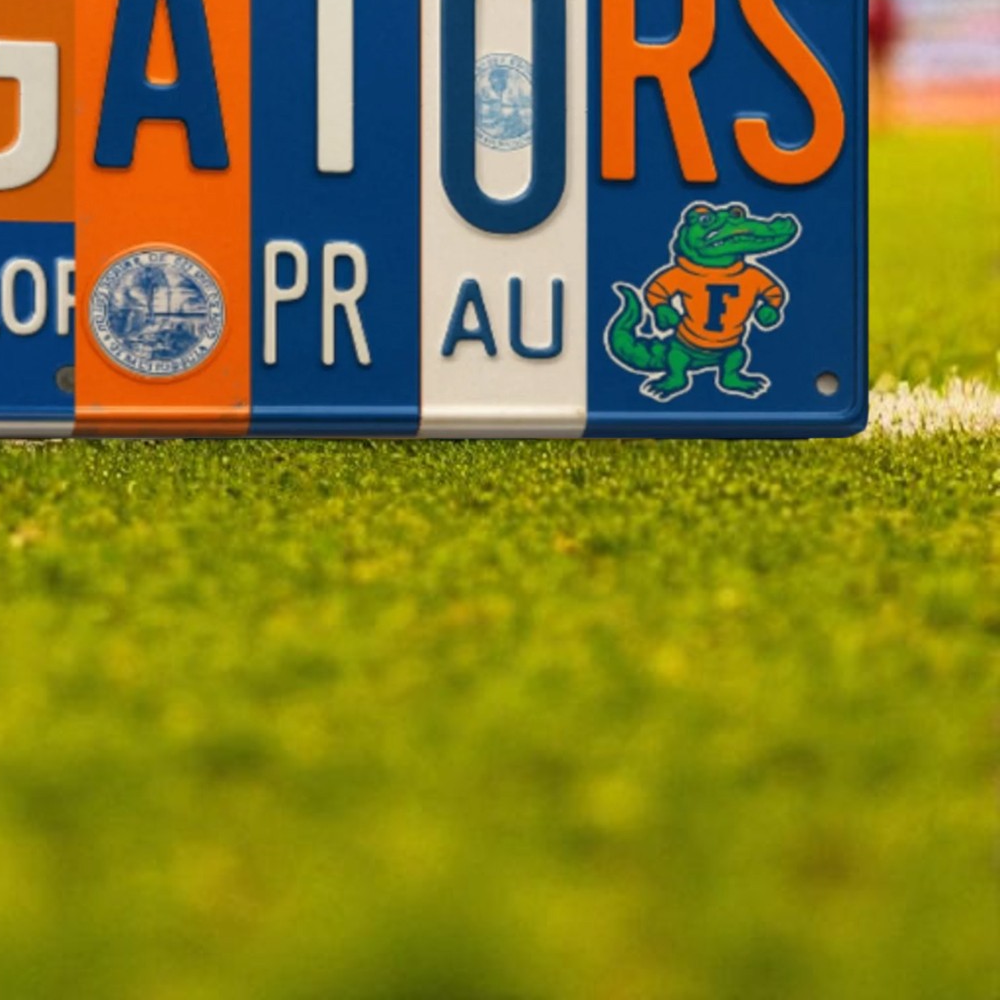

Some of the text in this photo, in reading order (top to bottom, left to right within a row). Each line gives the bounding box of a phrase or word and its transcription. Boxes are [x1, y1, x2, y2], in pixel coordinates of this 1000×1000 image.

[263, 240, 371, 366] PR
[440, 276, 564, 360] AU
[703, 284, 740, 333] F
